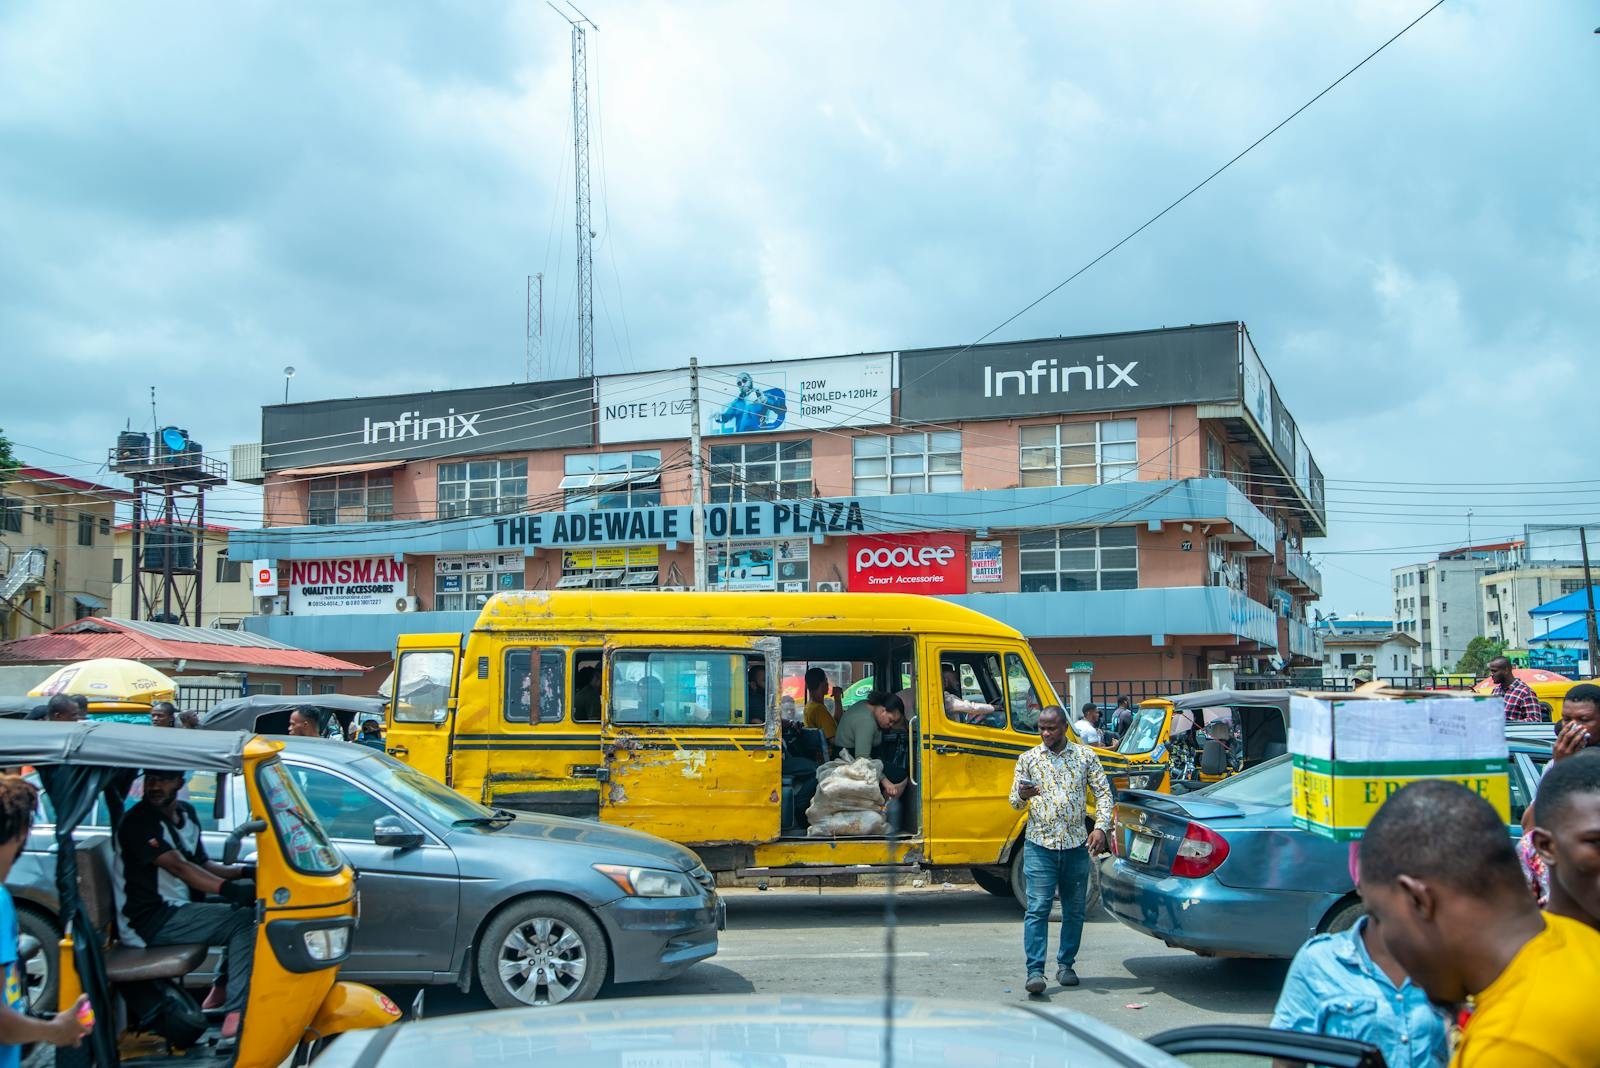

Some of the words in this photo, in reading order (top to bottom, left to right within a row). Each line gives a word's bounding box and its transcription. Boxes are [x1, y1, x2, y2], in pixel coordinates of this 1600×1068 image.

[984, 355, 1139, 398] Infinix
[802, 380, 826, 390] 120W
[801, 389, 878, 403] AMOLED+120Hz
[605, 403, 648, 420] NOTE
[651, 401, 667, 417] 12
[801, 405, 832, 416] 108MP
[363, 408, 480, 444] Infinix
[493, 516, 542, 546] THE
[552, 509, 678, 543] ADEWALE
[773, 501, 864, 534] PLAZA
[291, 558, 405, 585] NONSMAN
[868, 576, 893, 585] Smart
[896, 574, 945, 584] Accessories
[302, 585, 334, 596] QUALITY
[336, 585, 343, 594] IT
[345, 584, 394, 594] ACCESSORIES
